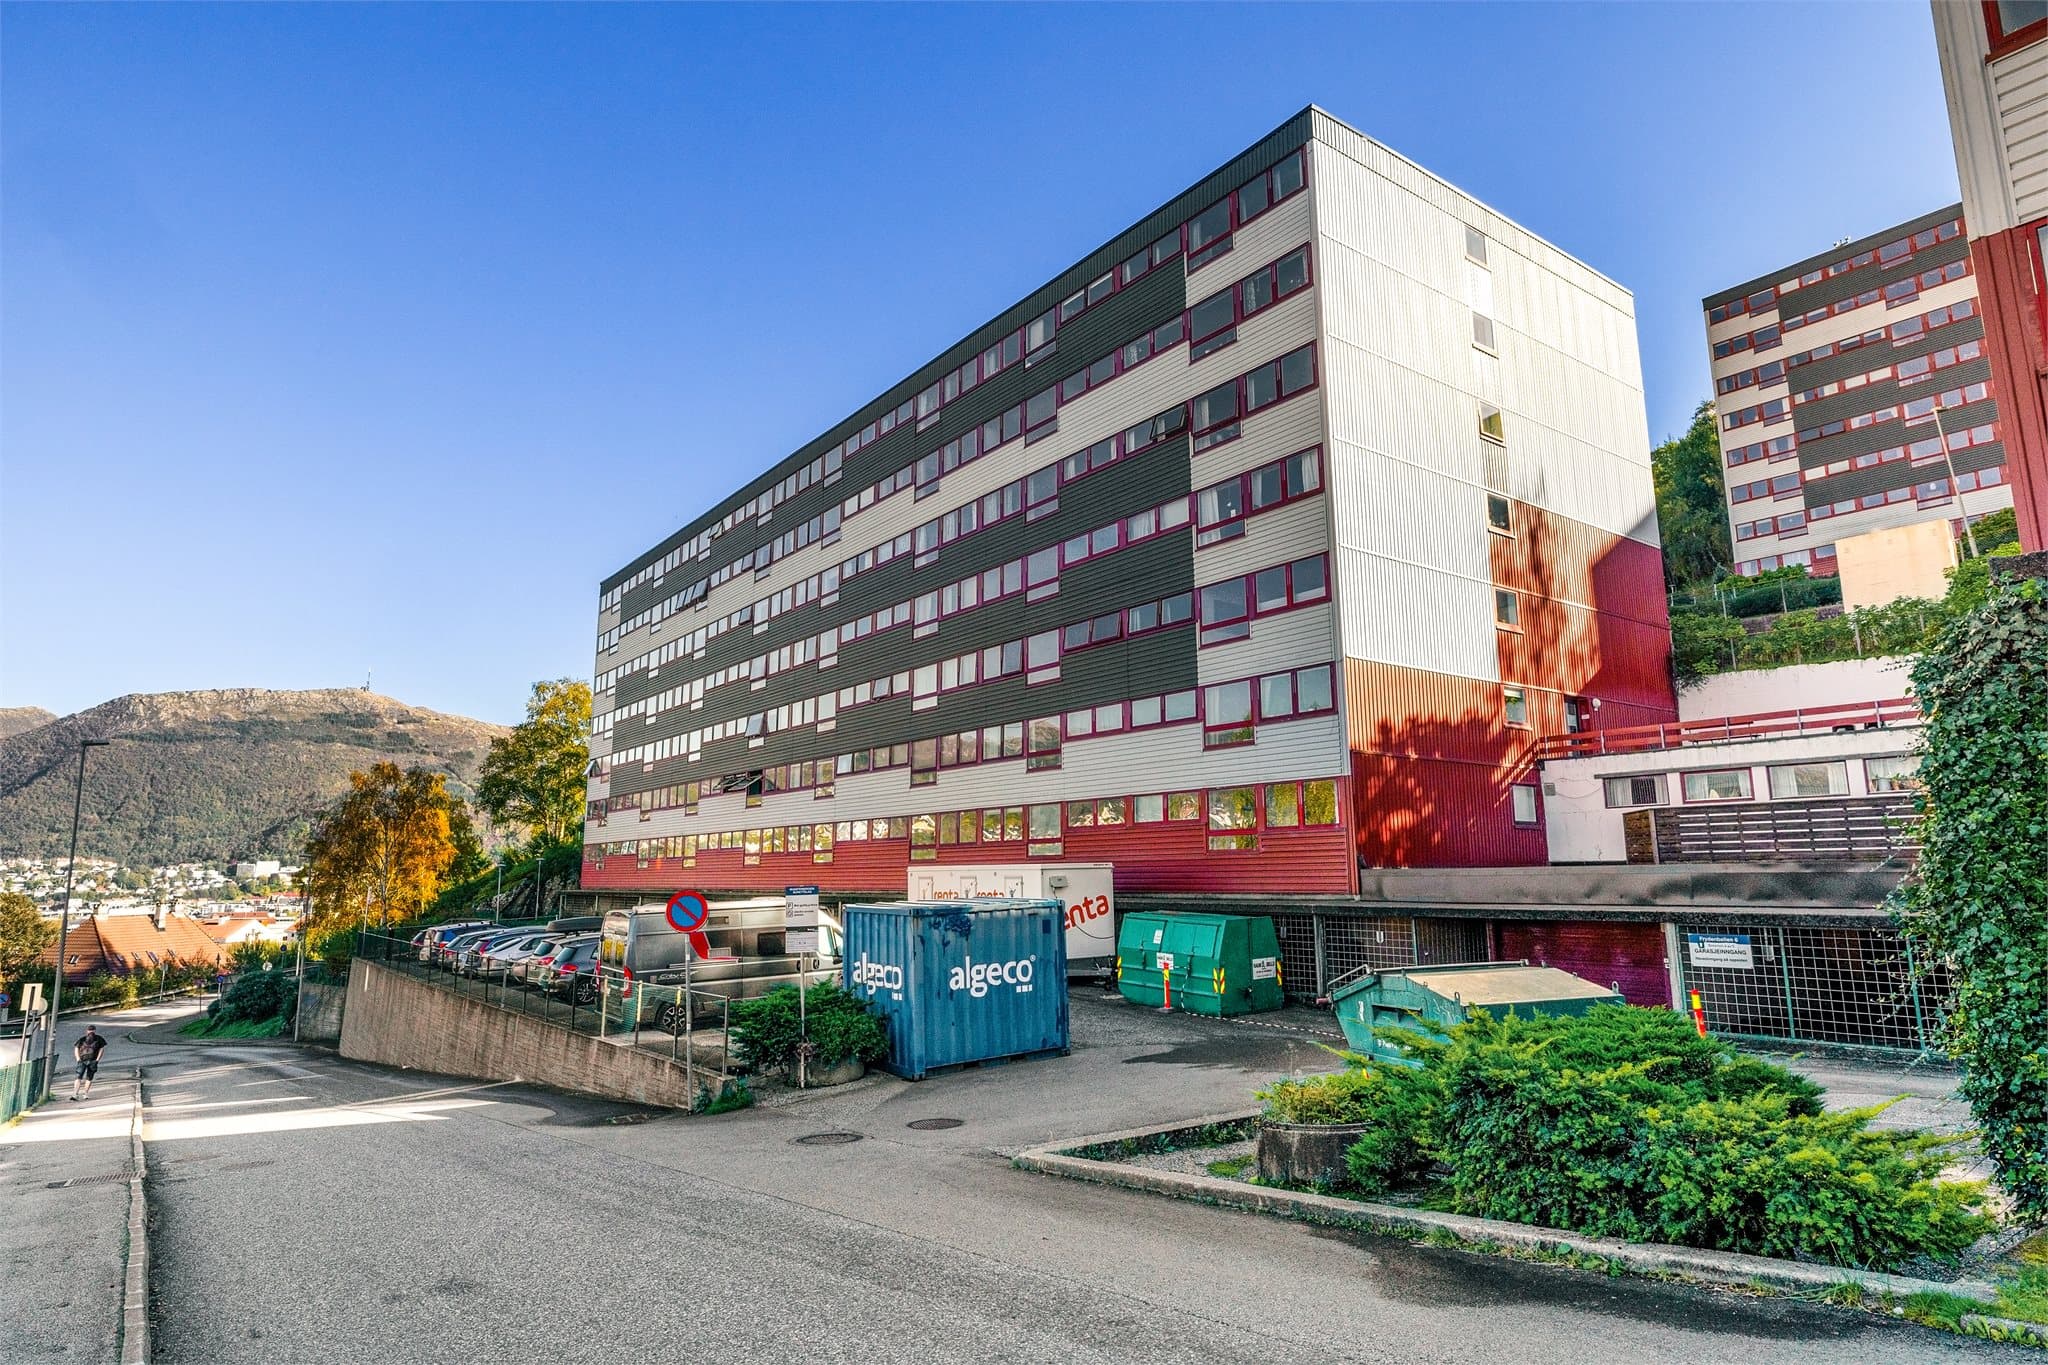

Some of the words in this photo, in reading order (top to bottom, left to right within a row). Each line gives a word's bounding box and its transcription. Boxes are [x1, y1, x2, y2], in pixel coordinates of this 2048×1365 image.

[934, 889, 959, 900] renta
[1064, 895, 1109, 930] nta
[853, 952, 902, 995] algeco
[950, 955, 1033, 998] algeco
